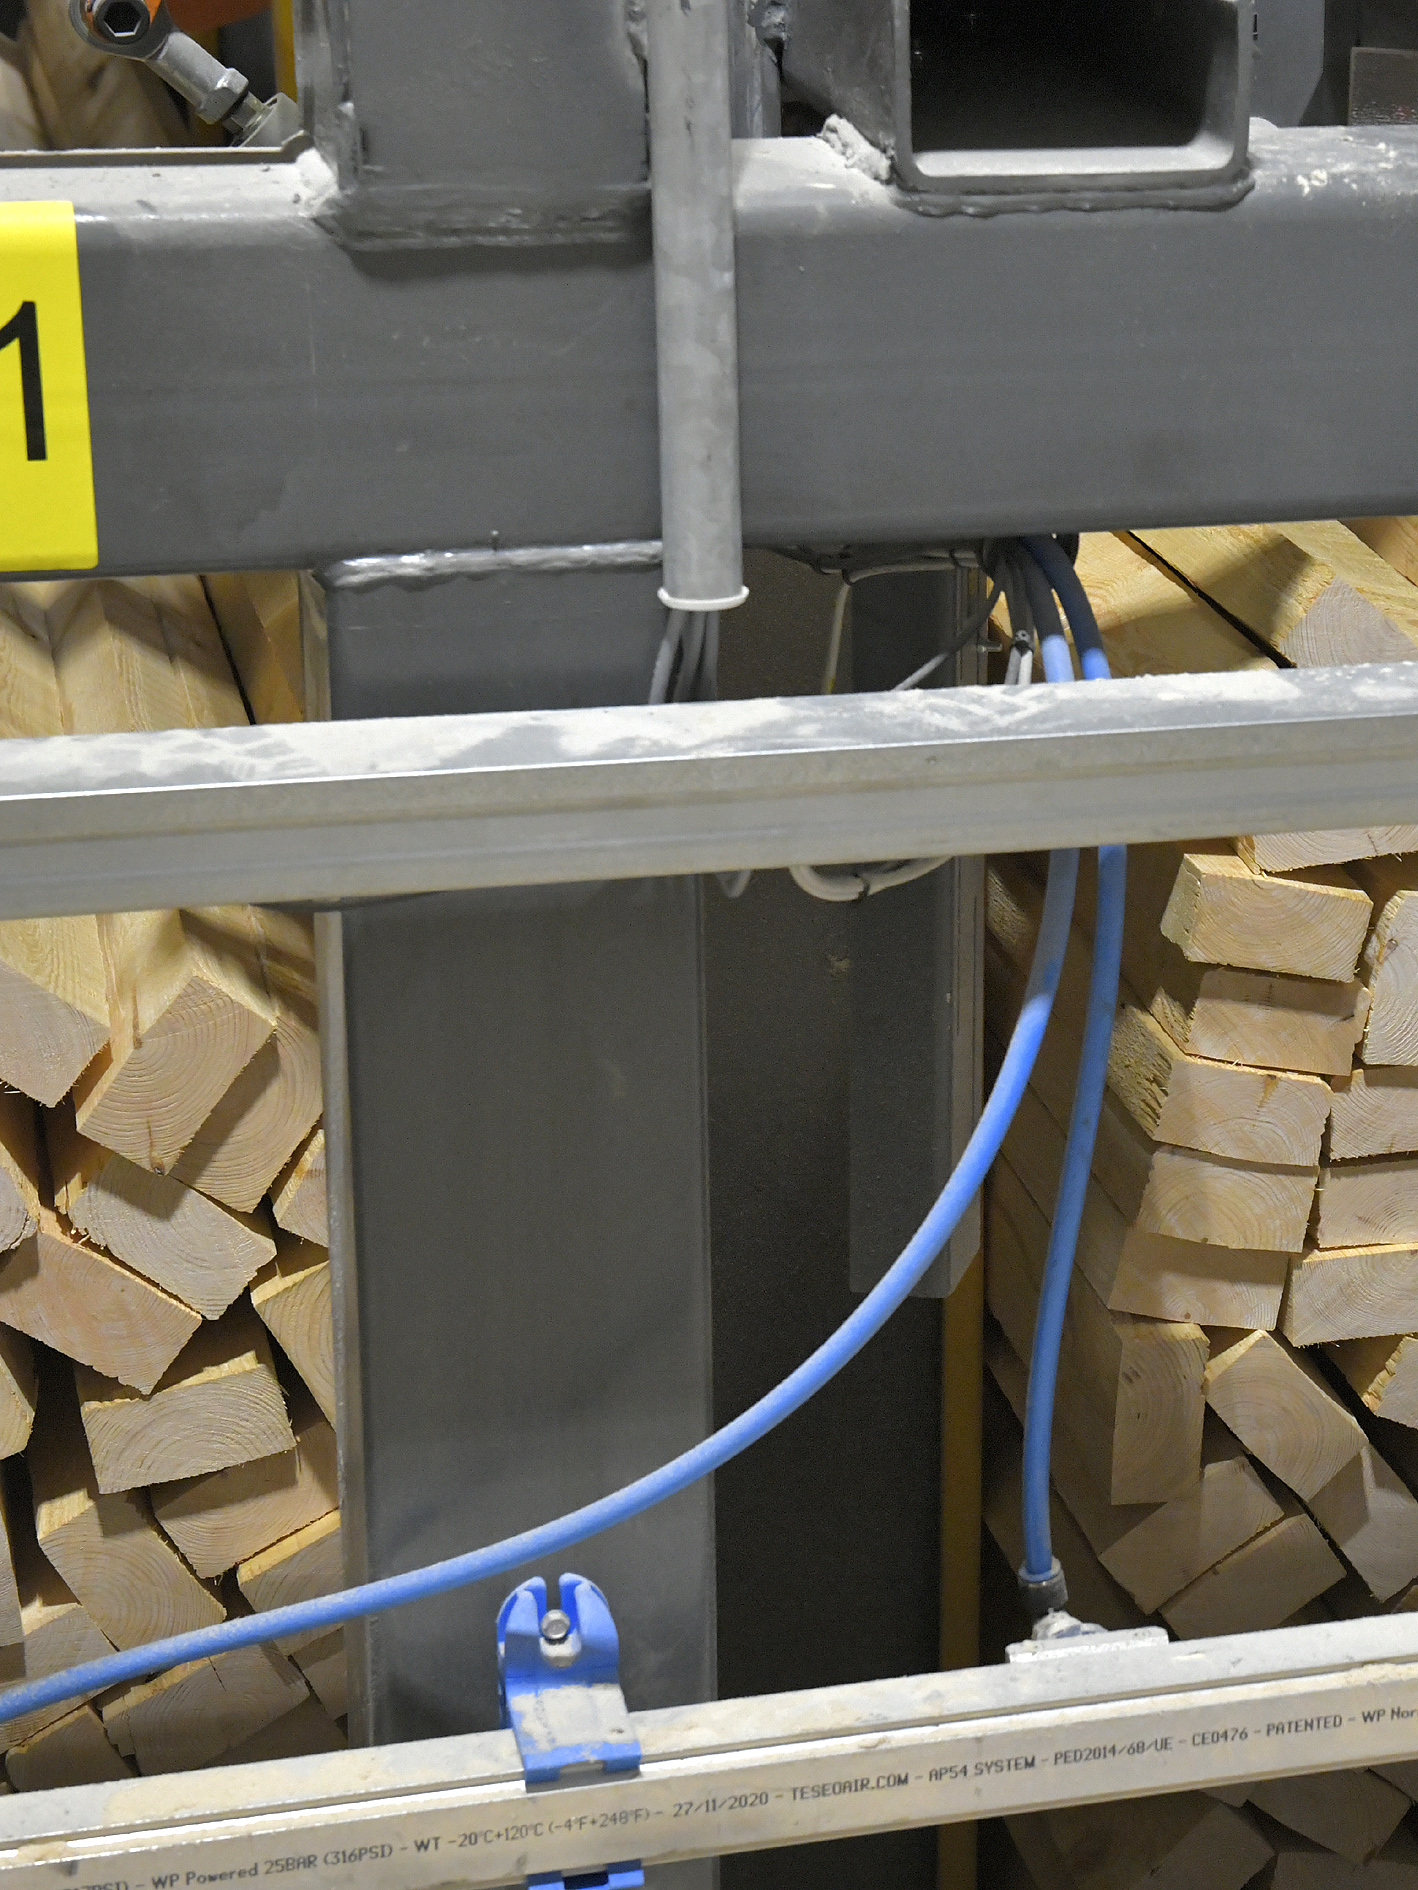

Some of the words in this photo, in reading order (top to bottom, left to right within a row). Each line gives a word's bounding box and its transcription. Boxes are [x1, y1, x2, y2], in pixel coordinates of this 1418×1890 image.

[151, 1873, 180, 1890] WP
[185, 1862, 259, 1886] Powered
[264, 1854, 318, 1875] 25BAR
[322, 1843, 393, 1866] (316PSI)
[413, 1836, 441, 1853] WT
[928, 1764, 968, 1782] AP54
[973, 1754, 1036, 1777] SYSTEM
[1191, 1727, 1249, 1748] CE0476
[1265, 1714, 1343, 1737] PATENTED
[1361, 1708, 1386, 1724] WP
